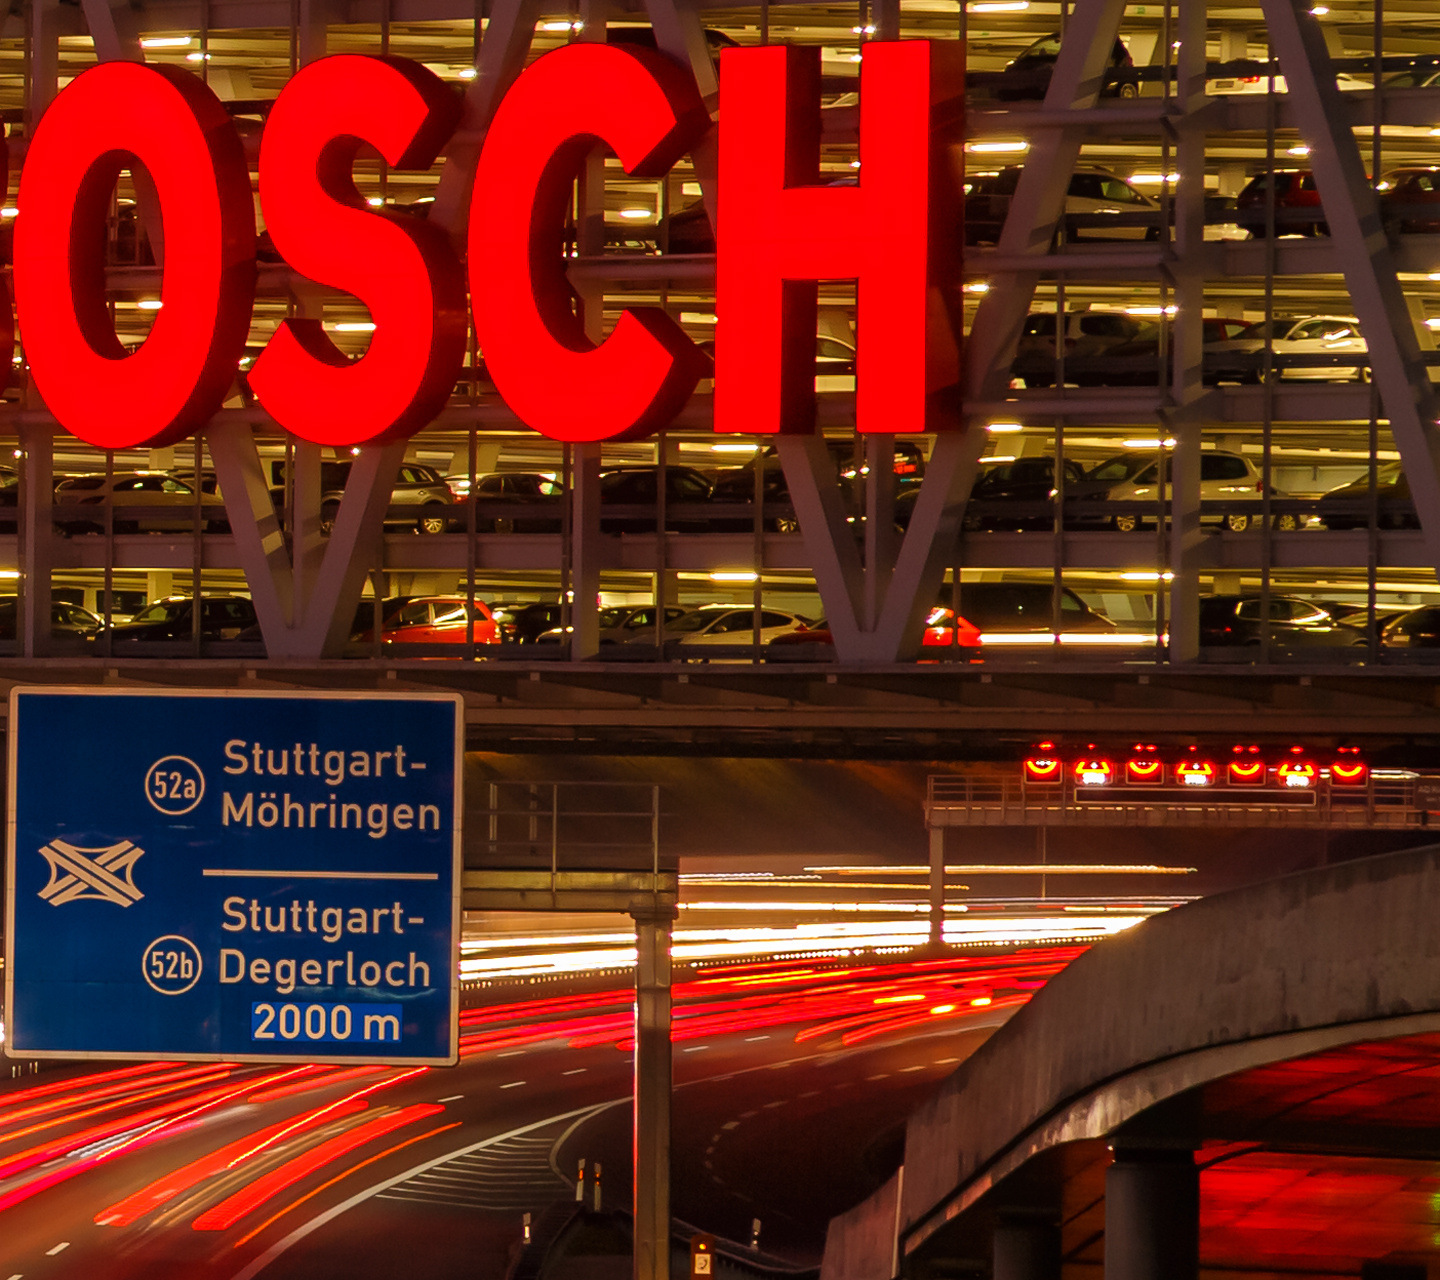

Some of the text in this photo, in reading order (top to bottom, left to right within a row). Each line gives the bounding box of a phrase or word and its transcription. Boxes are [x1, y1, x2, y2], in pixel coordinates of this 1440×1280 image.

[223, 738, 427, 785] Stuttgart-
[153, 771, 196, 800] 52a
[221, 792, 440, 838] Möhringen
[222, 896, 424, 942] Stuttgart-
[151, 951, 194, 979] 52b
[219, 948, 430, 995] Degerloch
[253, 1004, 400, 1041] 2000 m
